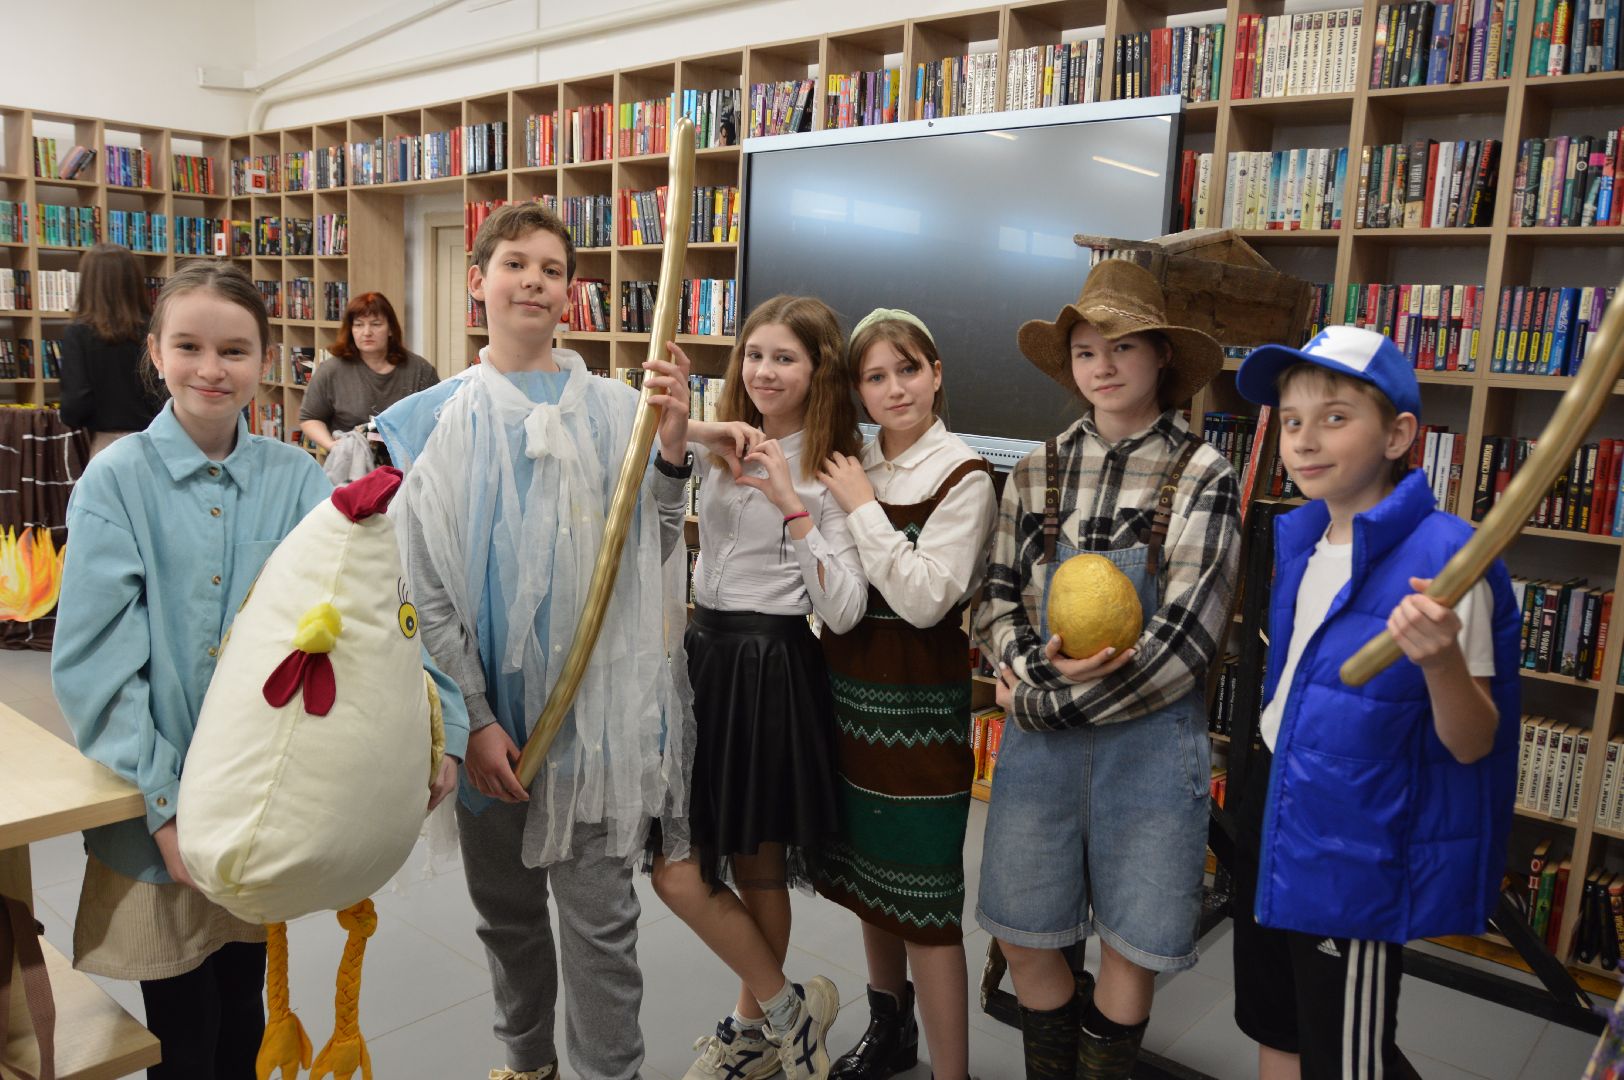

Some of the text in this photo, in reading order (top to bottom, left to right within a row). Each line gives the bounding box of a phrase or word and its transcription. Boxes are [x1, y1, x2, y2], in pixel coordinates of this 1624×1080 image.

[1470, 28, 1484, 81] МАЛЫШЕВА
[1483, 22, 1502, 79] МАЛЫШЕВА
[1410, 163, 1423, 197] МОЯ ВОЙНА
[1478, 444, 1493, 492] Юлиан СЕМЕНОВ
